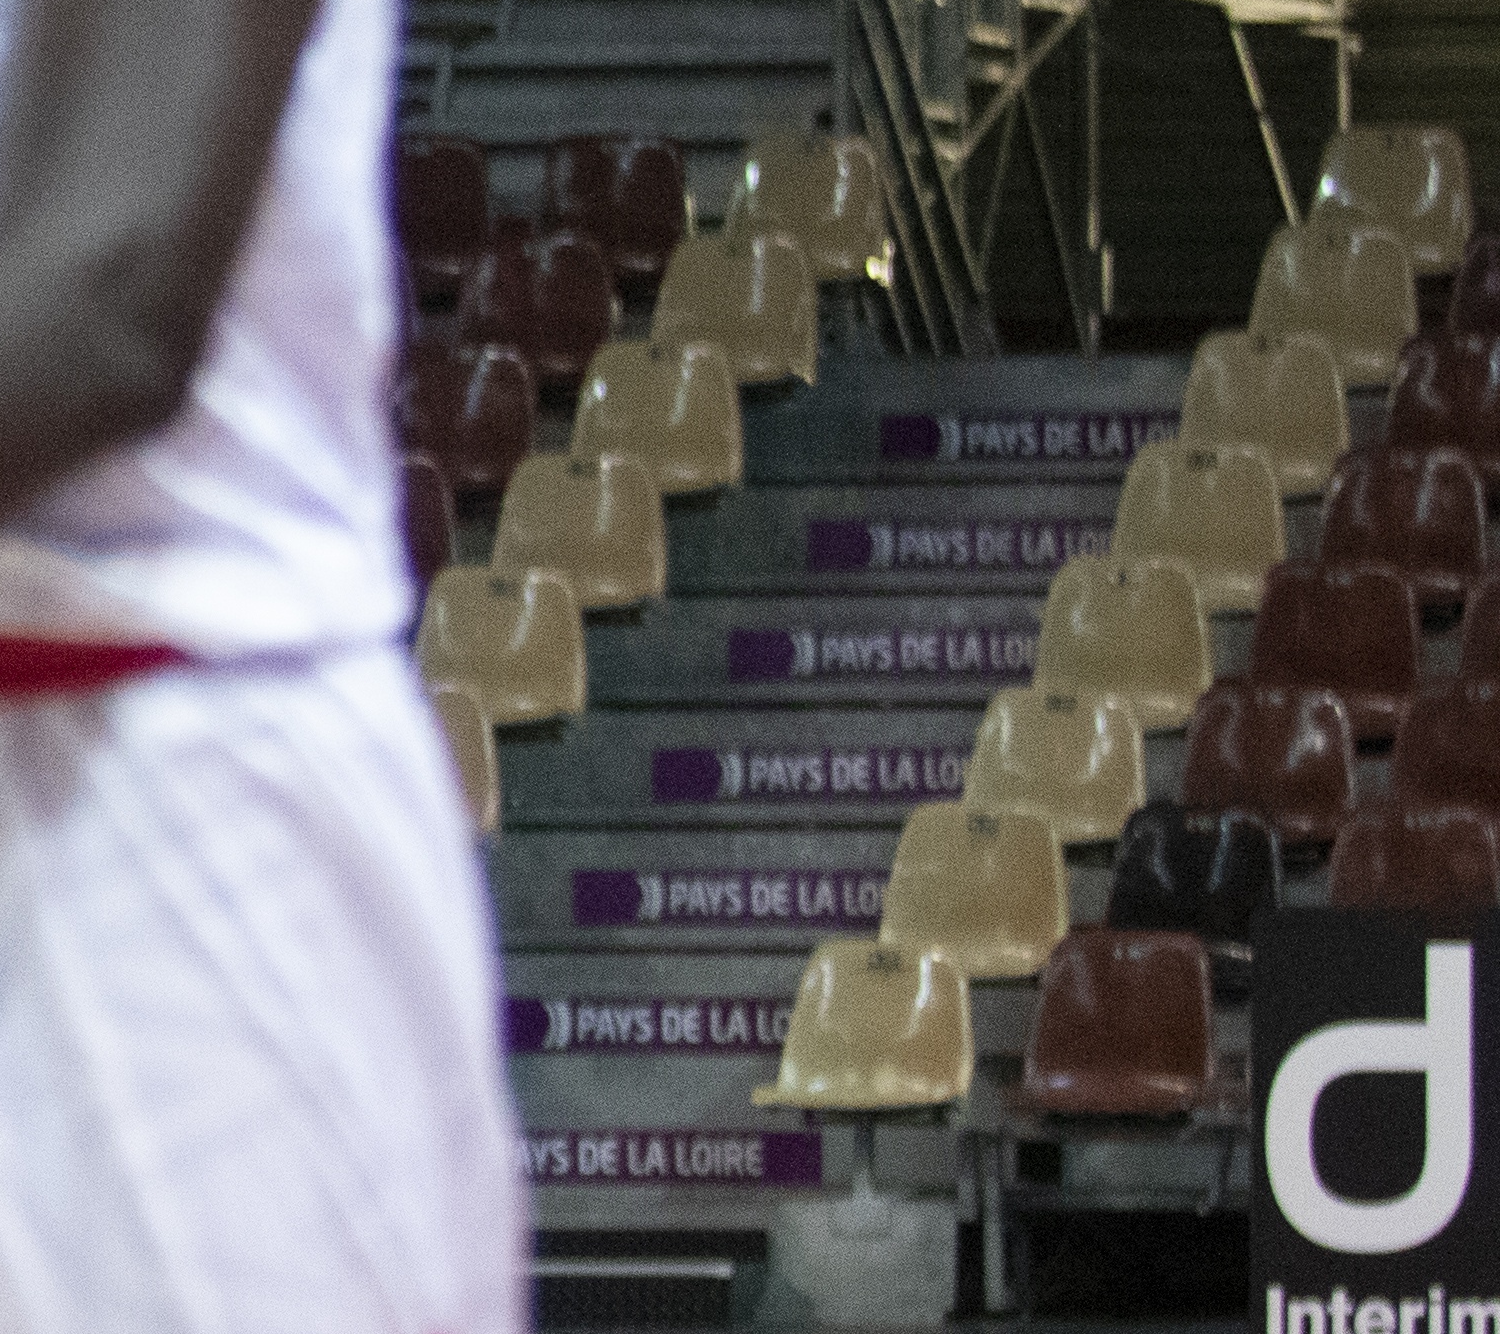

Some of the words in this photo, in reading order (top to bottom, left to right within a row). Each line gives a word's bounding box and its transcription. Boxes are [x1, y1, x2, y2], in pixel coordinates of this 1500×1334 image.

[965, 421, 1038, 457] PAYS
[1043, 421, 1082, 457] DE
[1087, 421, 1126, 457] LA
[898, 528, 969, 565] PAYS
[976, 528, 1014, 565] DE
[1021, 528, 1057, 565] LA
[821, 636, 894, 672] PAYS
[900, 636, 938, 672] DE
[945, 636, 982, 672] LA
[749, 754, 822, 792] PAYS
[830, 754, 871, 792] DE
[878, 754, 916, 792] LA
[668, 879, 744, 916] PAYS
[750, 879, 791, 916] DE
[797, 879, 836, 916] LA
[576, 1008, 654, 1044] PAYS
[661, 1008, 702, 1044] DE
[708, 1008, 750, 1044] LA
[576, 1139, 619, 1176] DE
[626, 1139, 668, 1176] LA
[674, 1139, 765, 1176] LOIRE
